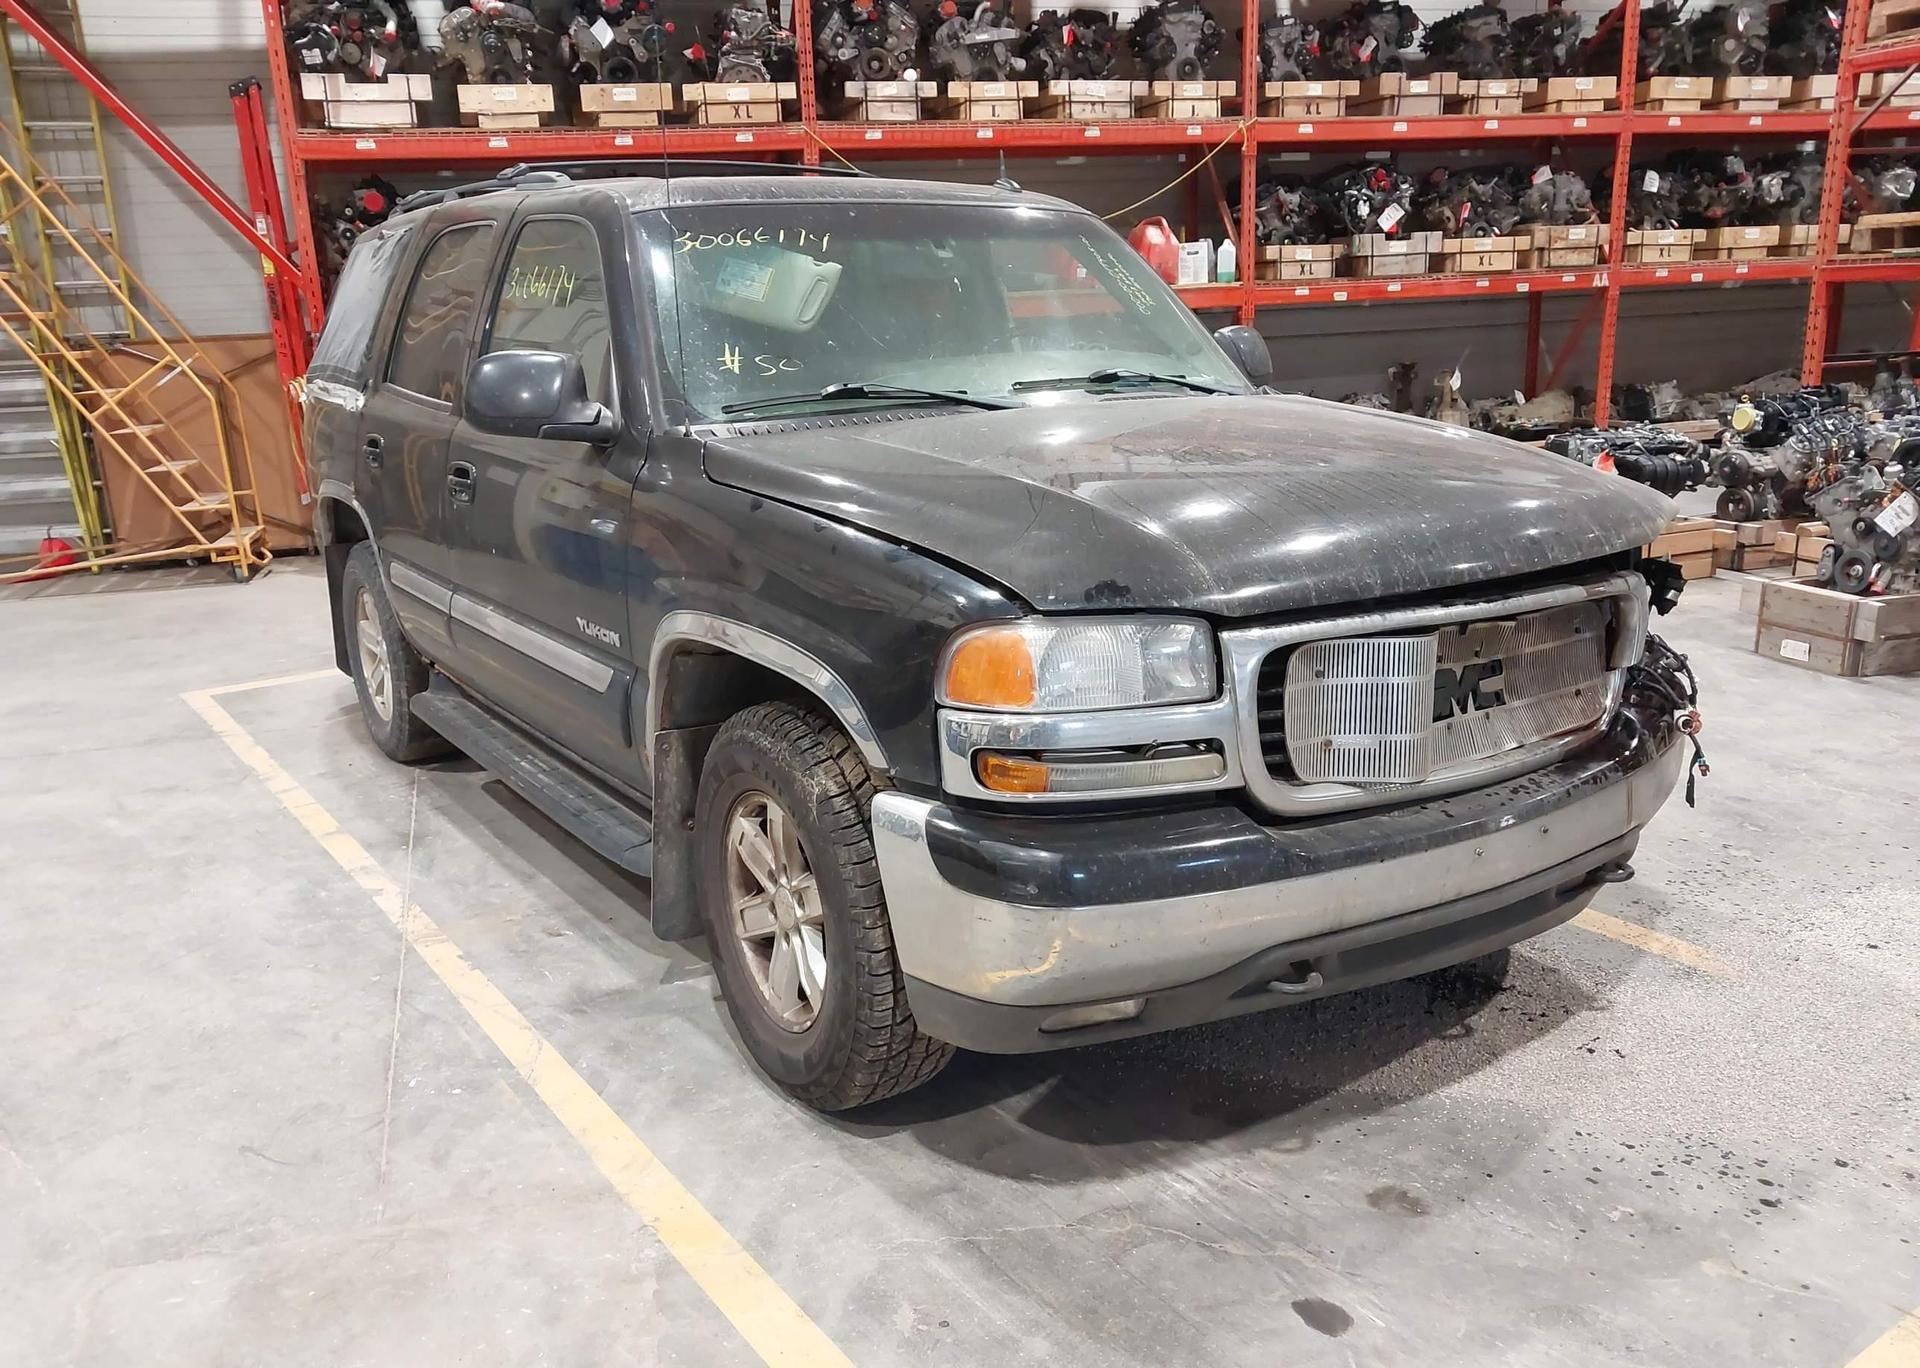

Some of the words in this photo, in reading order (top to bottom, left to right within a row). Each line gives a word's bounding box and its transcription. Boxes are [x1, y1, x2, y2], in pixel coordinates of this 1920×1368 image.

[733, 105, 753, 119] XL
[1305, 102, 1322, 115] XL
[1478, 255, 1494, 267] XL
[1300, 263, 1314, 276] XL
[576, 616, 621, 648] YUKON
